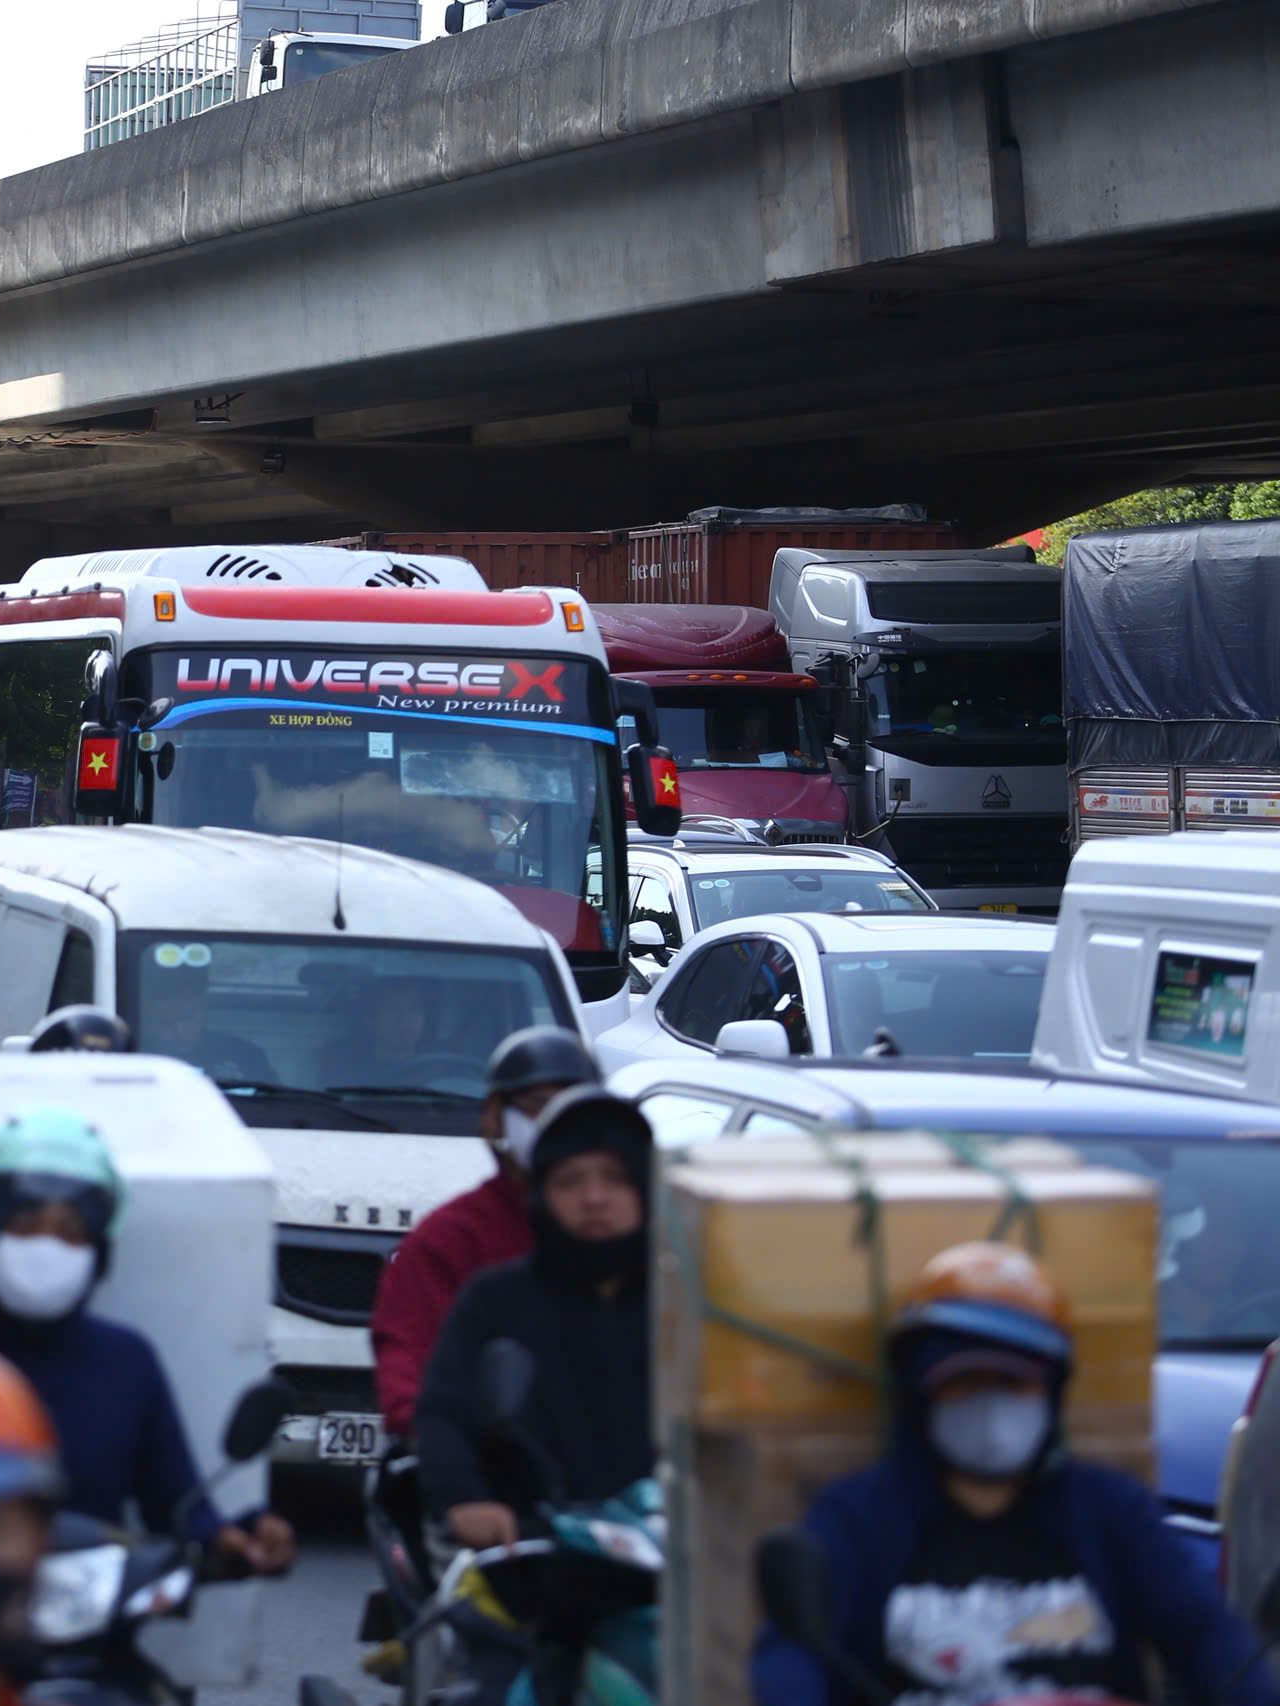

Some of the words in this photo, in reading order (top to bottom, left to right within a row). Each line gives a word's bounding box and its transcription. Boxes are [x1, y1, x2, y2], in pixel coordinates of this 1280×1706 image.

[376, 694, 433, 710] New
[443, 698, 563, 715] premium
[269, 714, 286, 725] XE
[288, 714, 314, 728] HỢP
[324, 1422, 376, 1455] 29D
